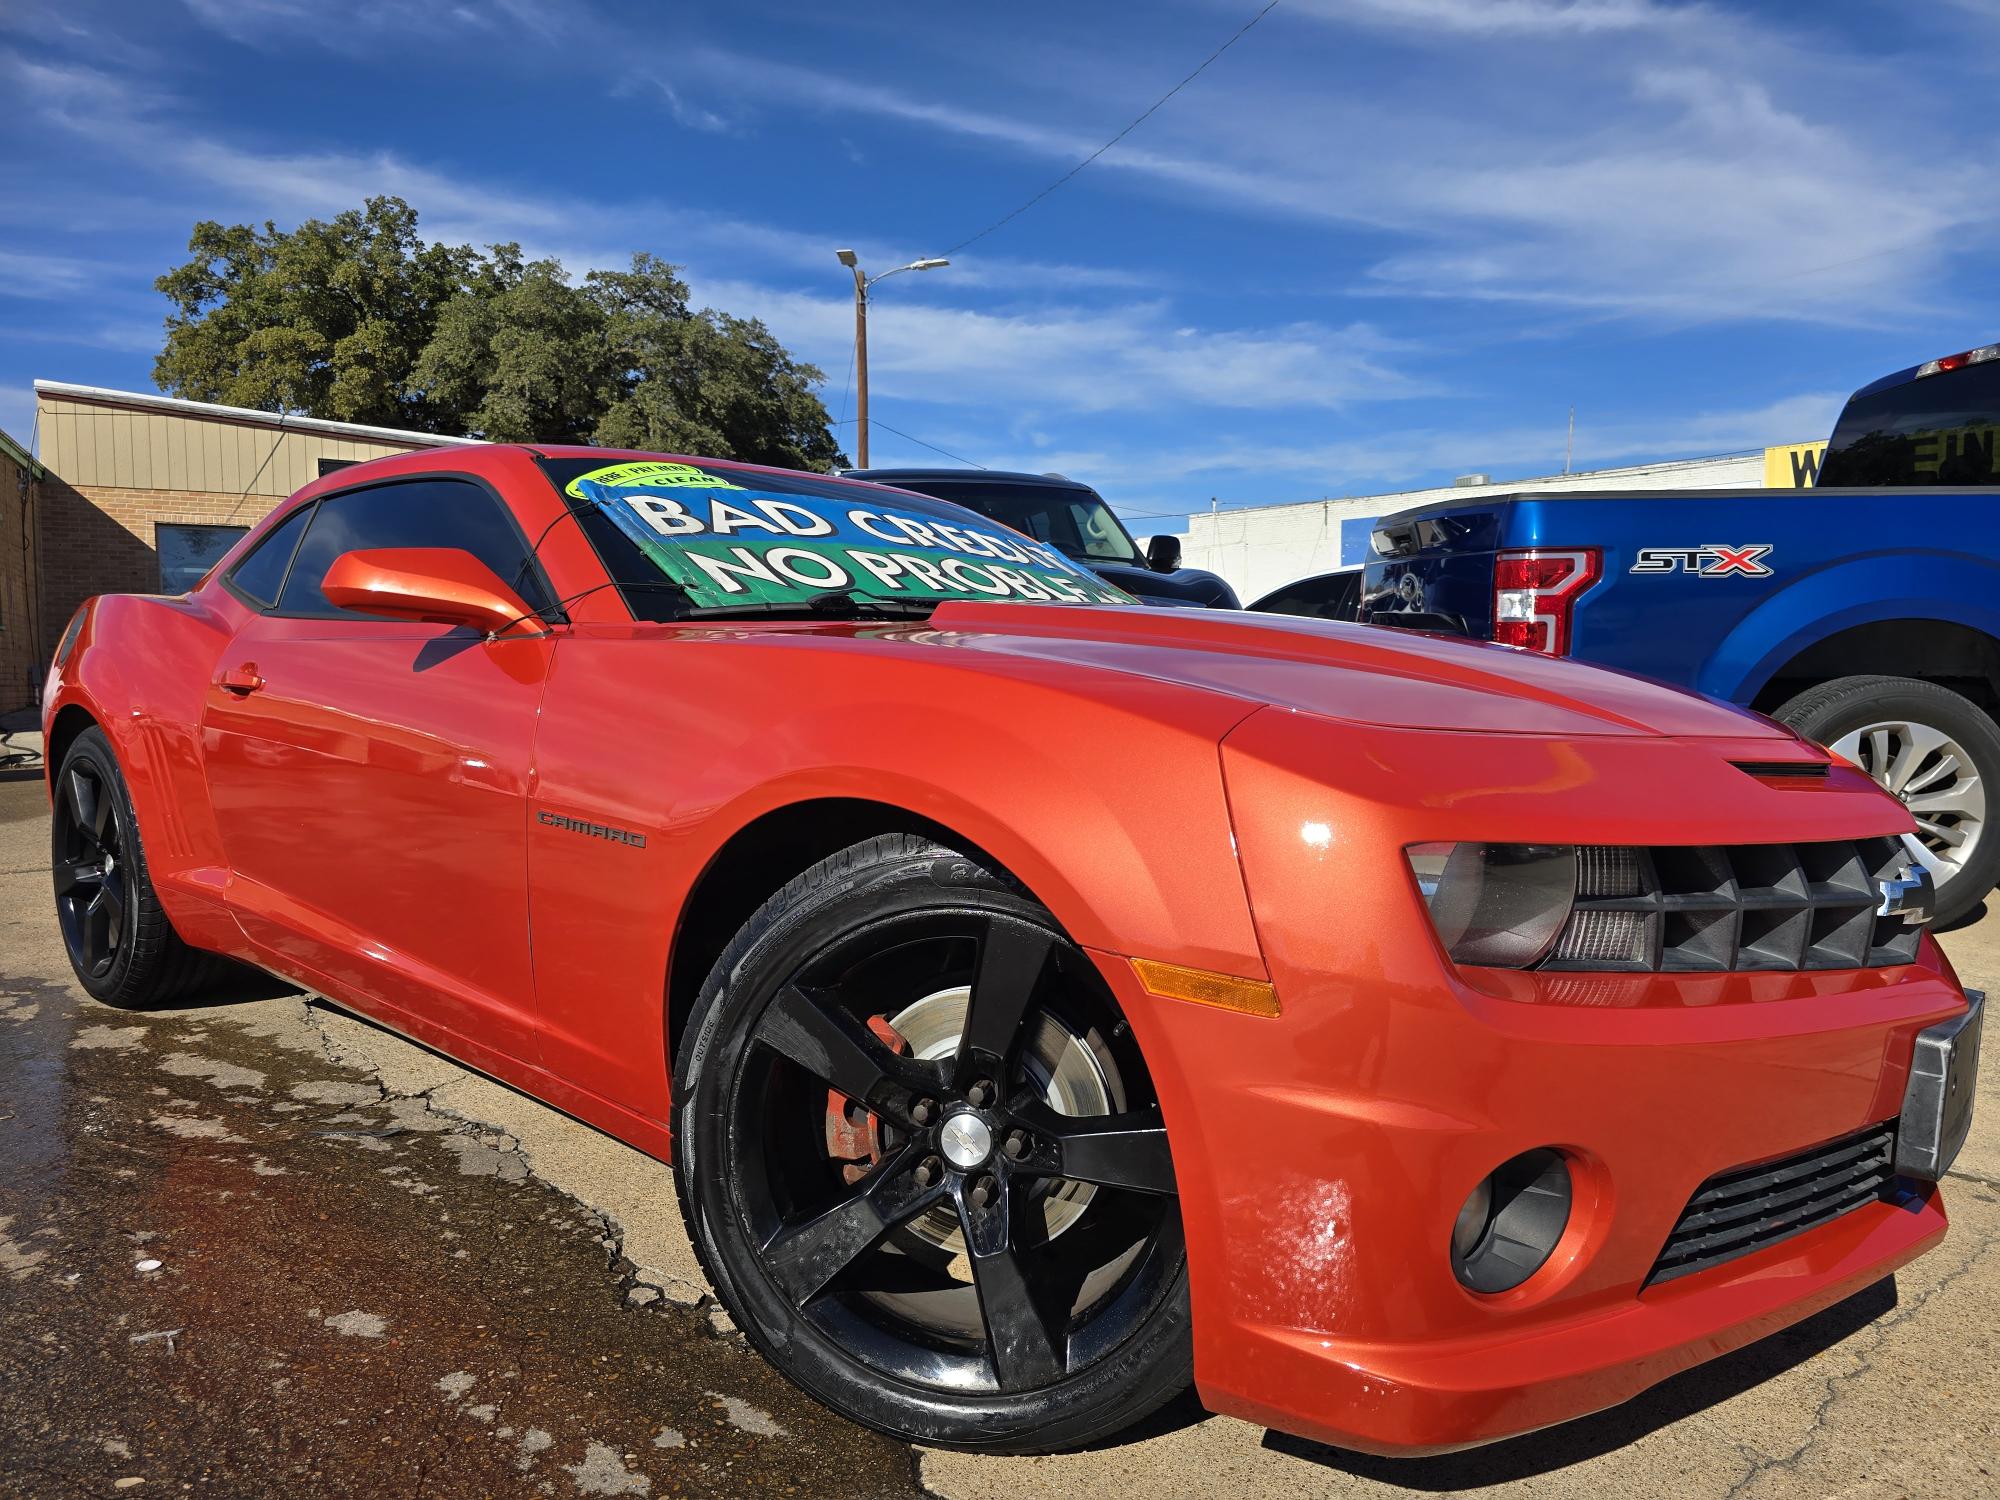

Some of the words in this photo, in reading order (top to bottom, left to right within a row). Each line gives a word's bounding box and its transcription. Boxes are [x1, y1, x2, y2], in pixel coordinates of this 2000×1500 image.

[630, 466, 655, 475] PAY
[658, 465, 689, 473] HERE
[654, 476, 716, 486] CLEAN
[623, 494, 839, 537] BAD
[847, 510, 1079, 576] CREDIT
[684, 546, 855, 594] NO
[1629, 544, 1775, 578] STX
[536, 810, 648, 849] CAMARO
[695, 1019, 715, 1062] OUTSIDE
